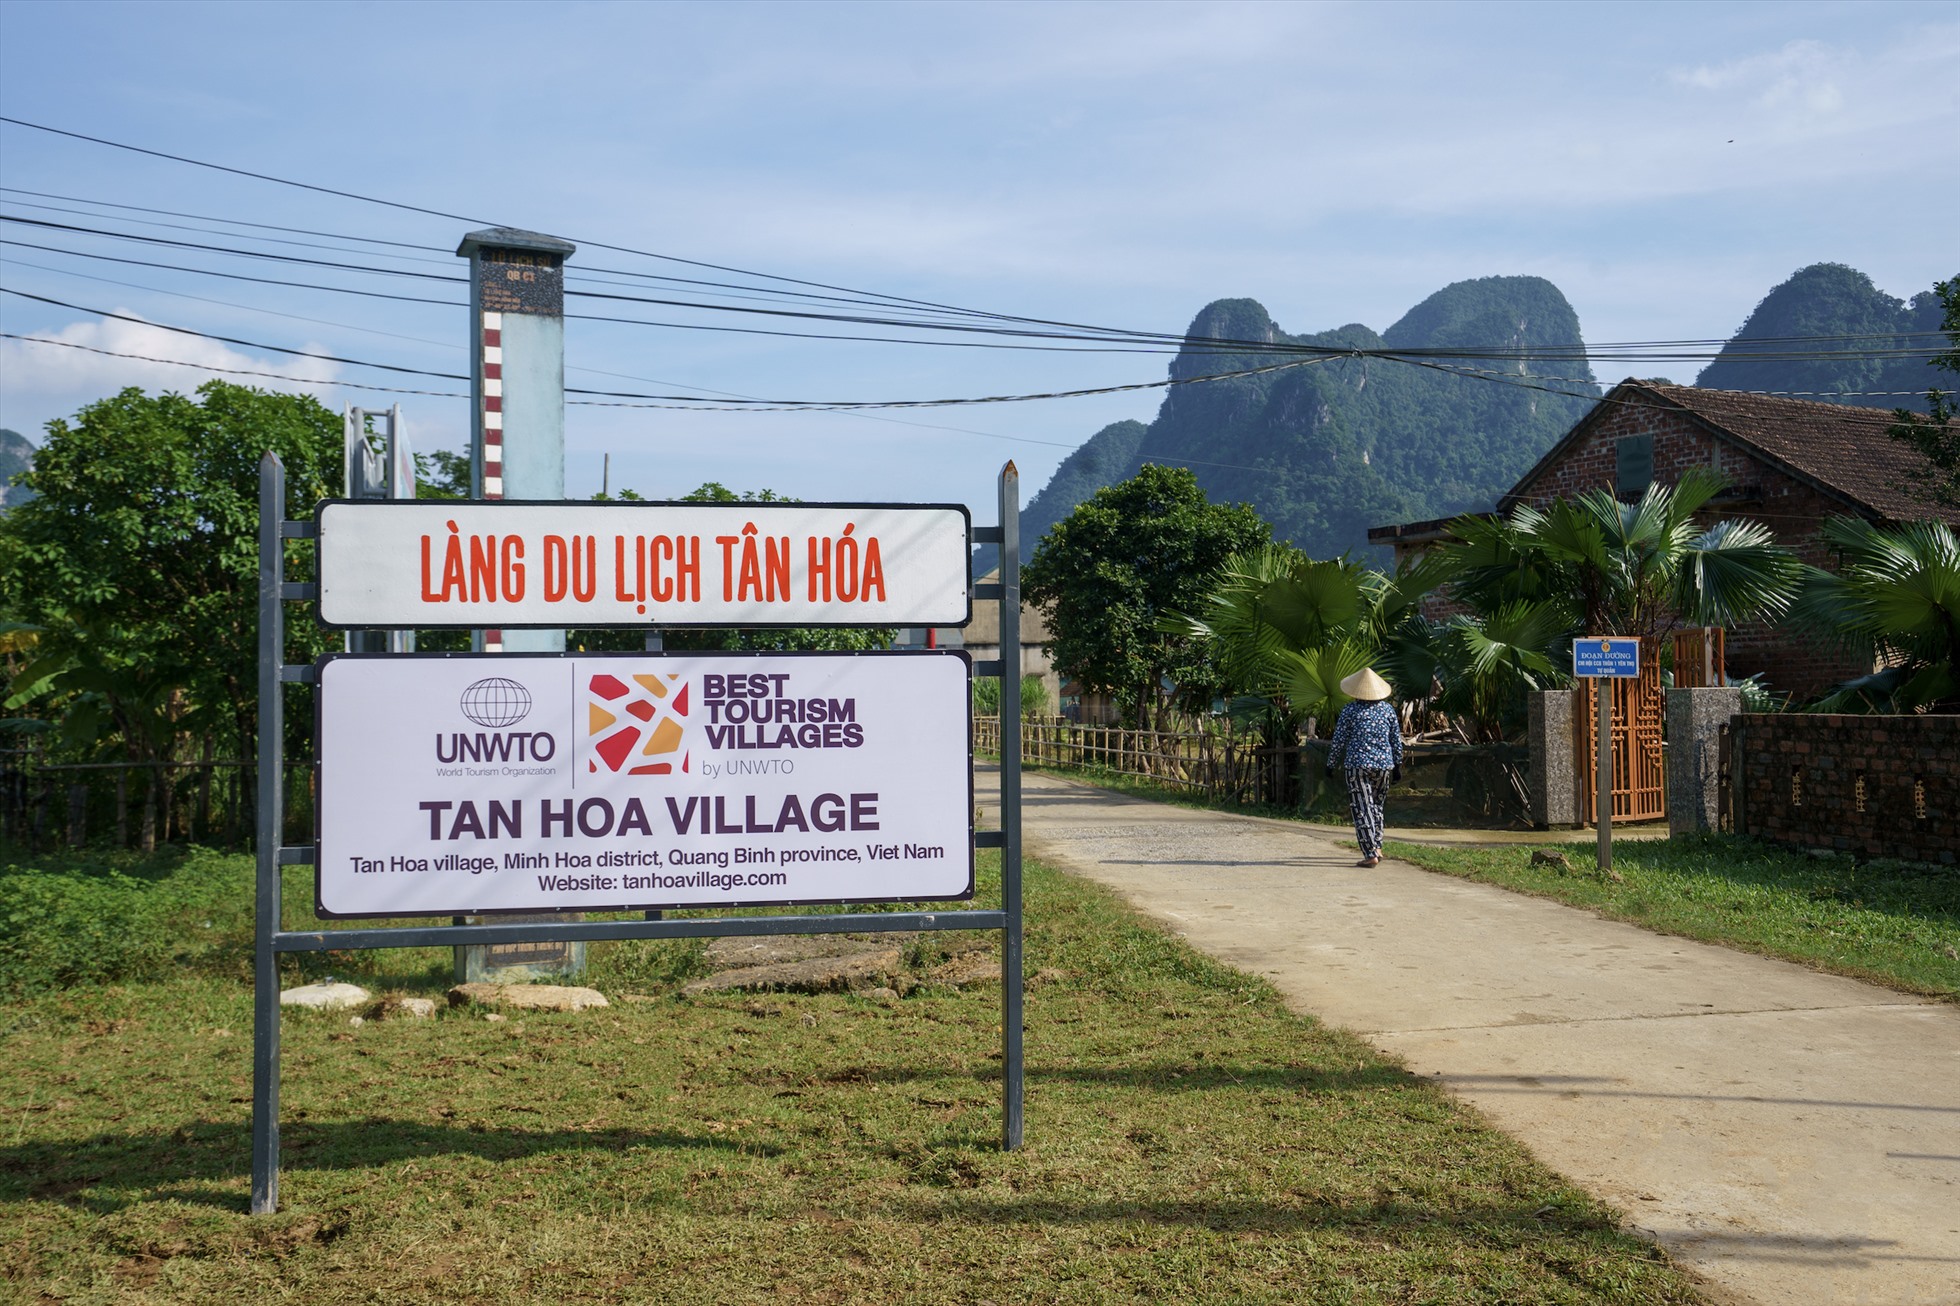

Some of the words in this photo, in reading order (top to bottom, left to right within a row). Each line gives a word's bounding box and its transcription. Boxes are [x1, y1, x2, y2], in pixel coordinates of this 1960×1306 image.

[507, 270, 520, 282] QB
[421, 520, 525, 603] LÀNG
[544, 535, 596, 602] DU
[616, 535, 700, 614] LỊCH
[716, 522, 790, 602] TÂN
[808, 523, 886, 602] HÓA
[704, 674, 789, 698] BEST
[704, 697, 857, 725] TOURISM
[437, 732, 555, 763] UNWTO
[705, 723, 864, 749] VILLAGES
[436, 768, 461, 776] World
[465, 767, 499, 776] Tourism
[502, 767, 557, 777] Organization
[703, 760, 721, 780] by
[727, 760, 793, 775] UNWTO
[419, 800, 521, 840] TAN
[541, 797, 653, 838] HOA
[665, 793, 879, 835] VILLAGE
[350, 857, 384, 873] Tan
[391, 856, 428, 872] Hoa
[434, 855, 498, 874] village,
[505, 853, 549, 869] Minh
[556, 852, 591, 868] Hoa
[597, 850, 662, 868] district,
[669, 849, 728, 868] Quang
[735, 848, 774, 863] Binh
[781, 846, 861, 867] province,
[867, 845, 899, 859] Viet
[905, 844, 943, 859] Nam
[538, 875, 617, 891] Website:
[623, 872, 786, 889] tanhoavillage.com
